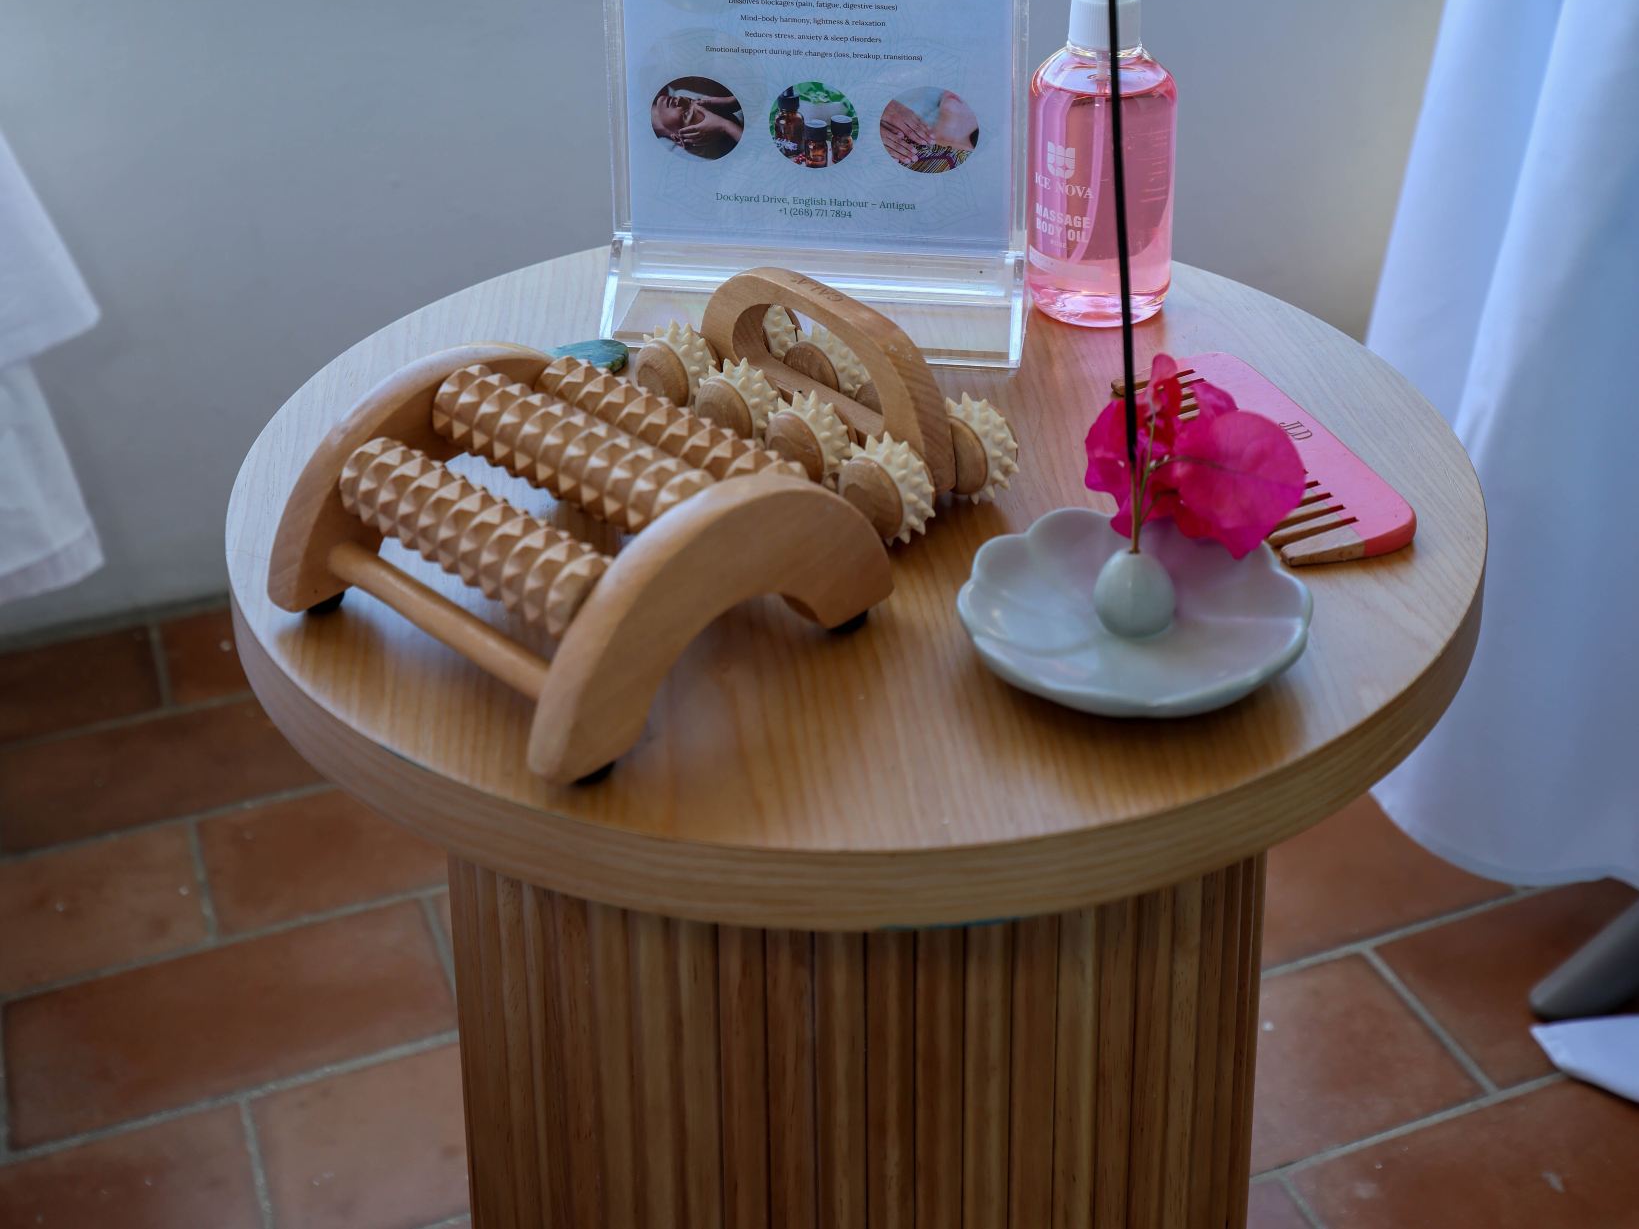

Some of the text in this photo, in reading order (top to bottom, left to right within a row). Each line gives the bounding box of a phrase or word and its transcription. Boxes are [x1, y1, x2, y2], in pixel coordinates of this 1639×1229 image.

[795, 0, 815, 9] (pain,
[816, 1, 842, 9] fatigue,
[842, 2, 873, 11] digestive
[874, 3, 898, 11] issues)
[740, 14, 886, 27] Mind-body harmony, lightness & relaxation
[744, 30, 772, 38] Reduces
[797, 33, 822, 41] anxiety
[830, 35, 848, 44] sleep
[849, 35, 882, 44] disorders
[705, 45, 740, 53] Emotional
[741, 46, 768, 56] support
[768, 47, 791, 57] during
[792, 48, 803, 56] life
[804, 49, 832, 59] changes
[883, 53, 923, 62] transitions)
[1035, 172, 1095, 199] ICE NOVA
[715, 192, 760, 204] Dockyard
[762, 195, 790, 206] Drive,
[792, 196, 827, 208] English
[829, 197, 869, 208] Harbour
[879, 200, 916, 211] Antigua
[778, 207, 853, 219] +1 (268) 771 7894
[1035, 202, 1091, 229] MASSAGE
[1036, 217, 1063, 236] BODY
[1067, 229, 1089, 244] OIL
